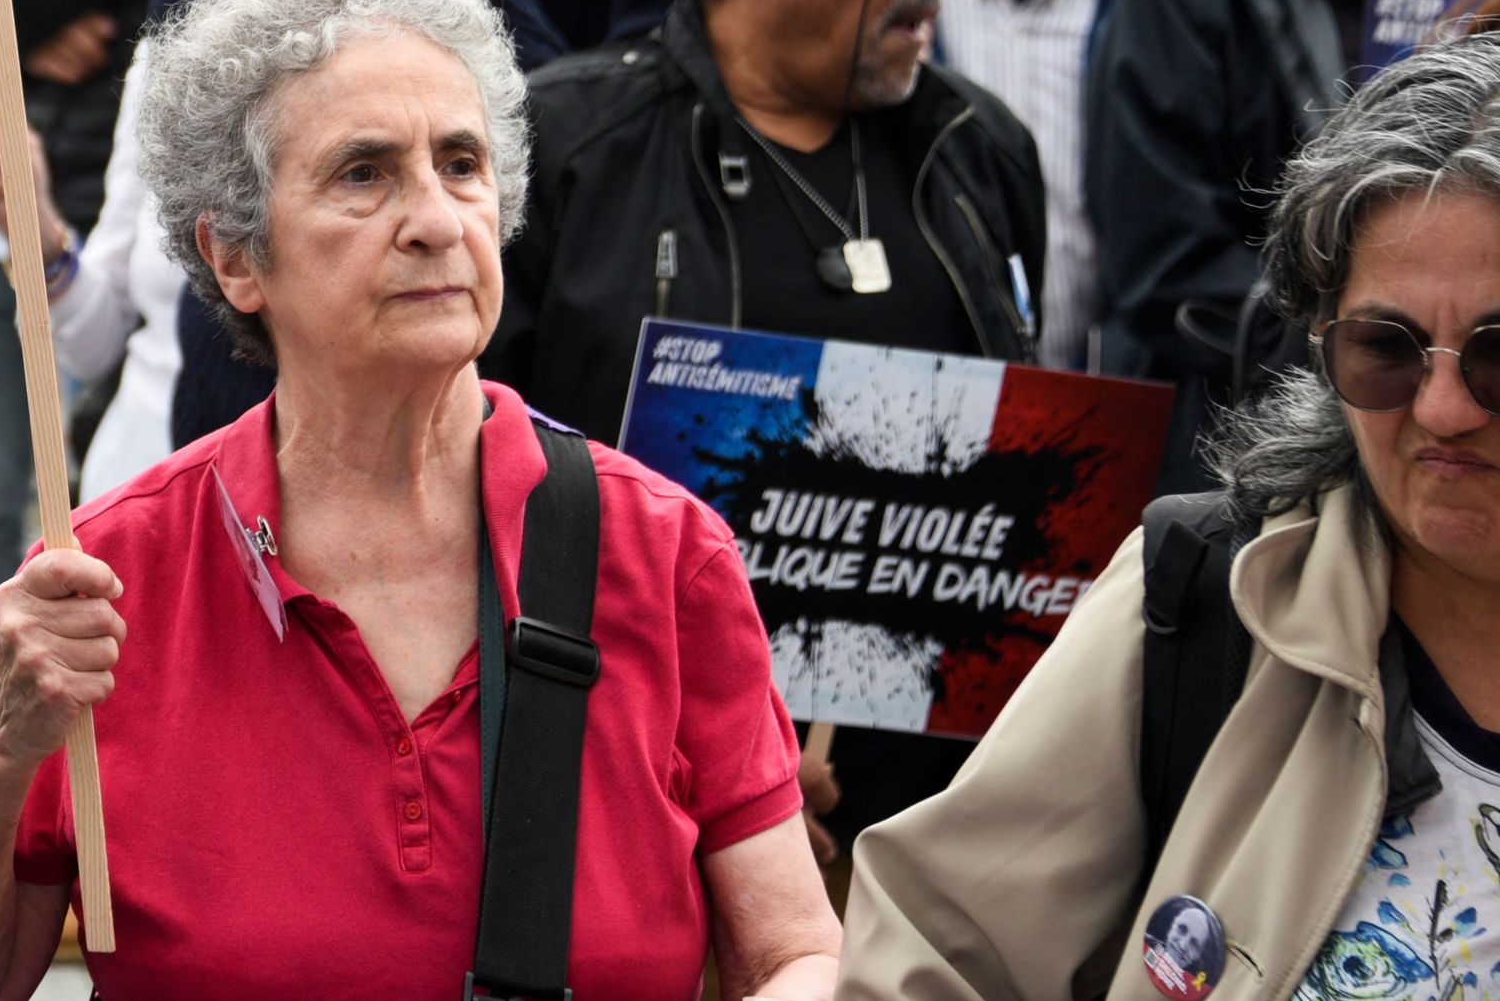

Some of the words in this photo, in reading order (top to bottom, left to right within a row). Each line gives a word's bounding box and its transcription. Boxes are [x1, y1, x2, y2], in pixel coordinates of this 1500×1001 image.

[652, 335, 723, 365] #STOP
[647, 360, 802, 400] ANTISÉMITISME
[750, 489, 876, 545] JUIVE
[878, 502, 1015, 561] VIOLÉE
[867, 555, 930, 598] EN
